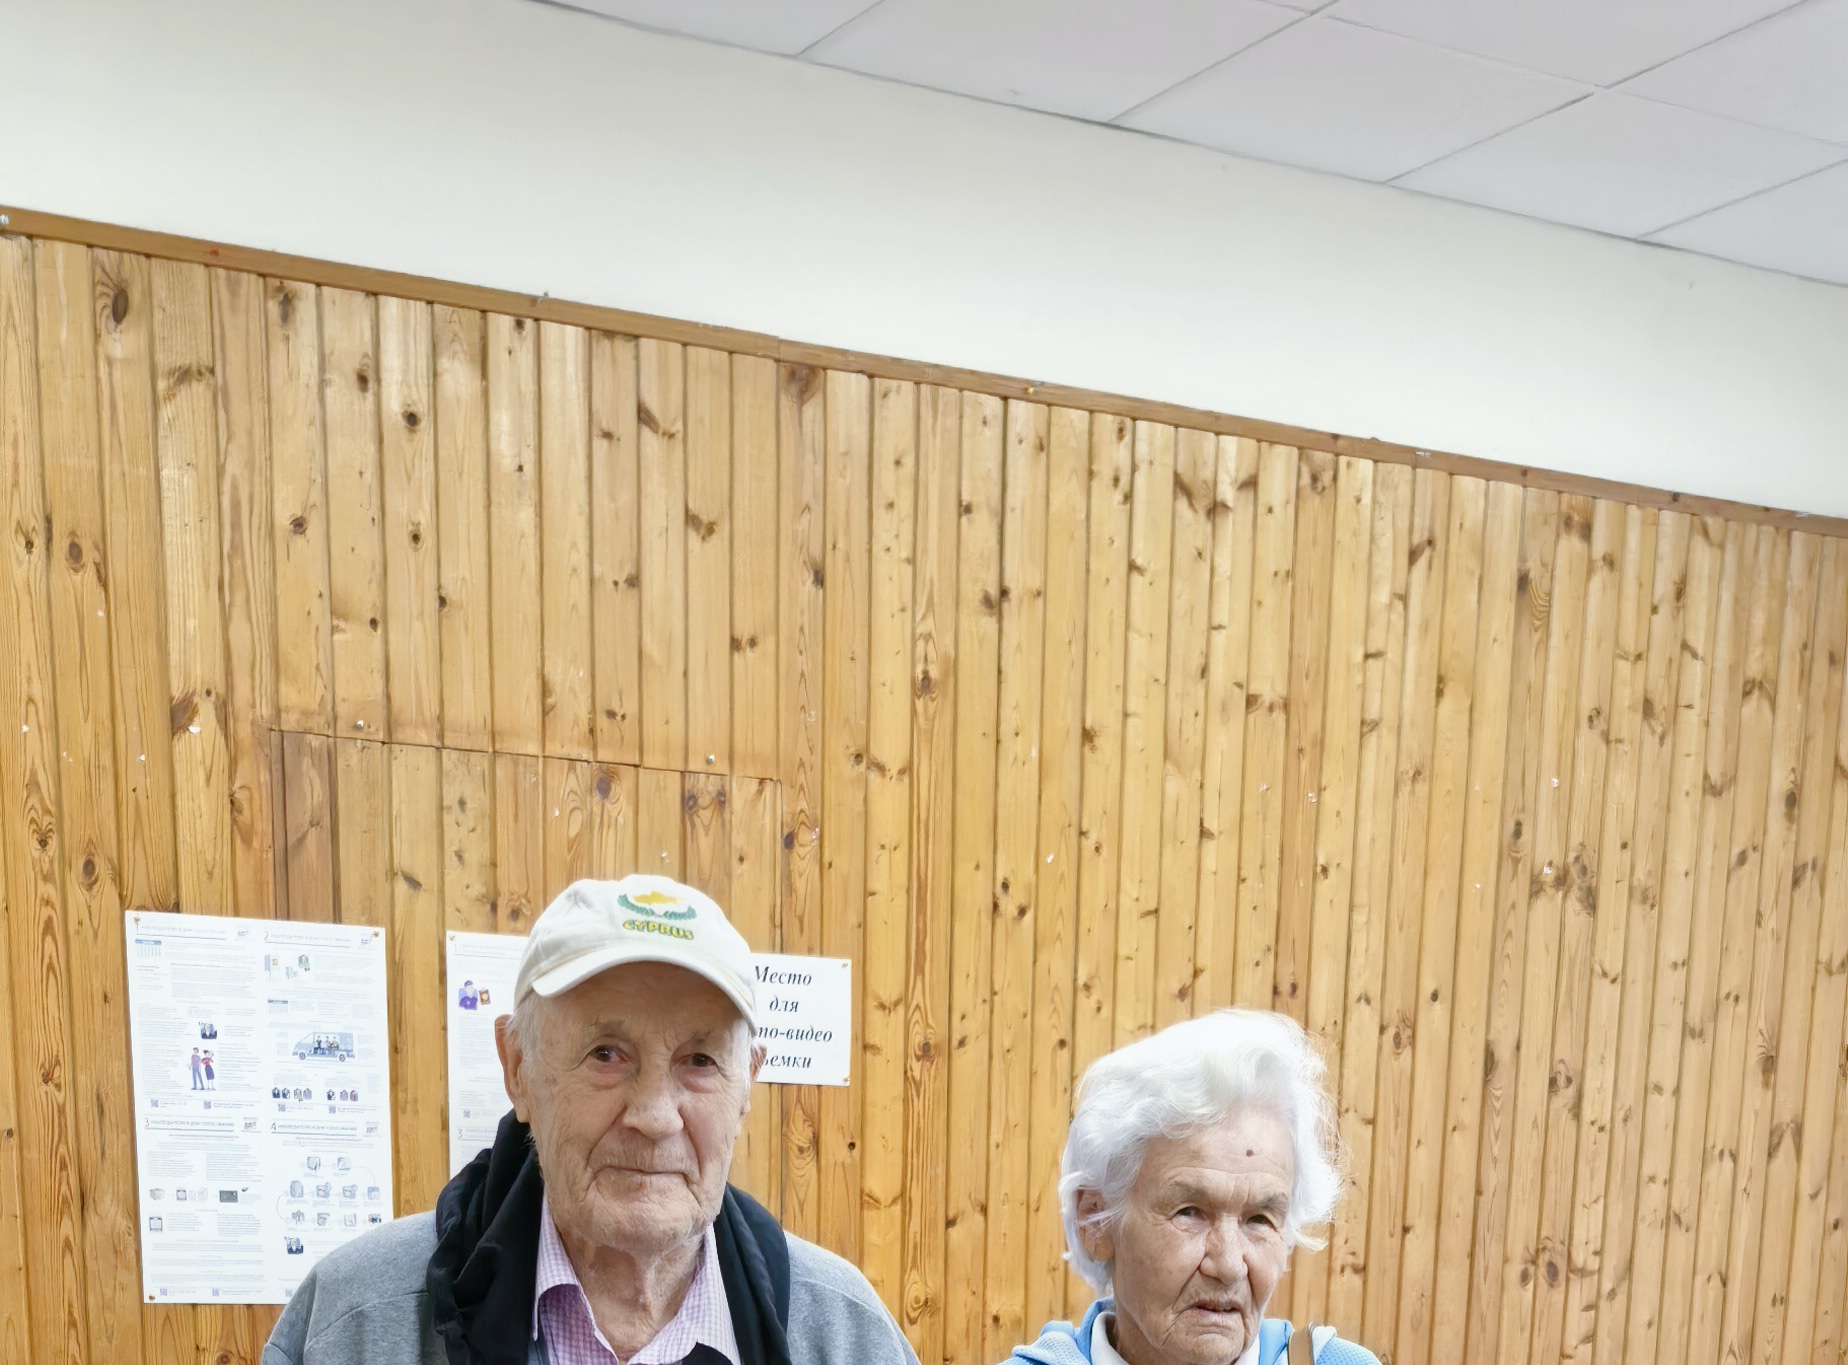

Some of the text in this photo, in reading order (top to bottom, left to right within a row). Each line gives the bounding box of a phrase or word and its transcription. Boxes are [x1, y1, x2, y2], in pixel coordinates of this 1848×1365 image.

[623, 919, 695, 941] CYPRUS
[754, 965, 812, 986] Место
[769, 994, 799, 1013] для
